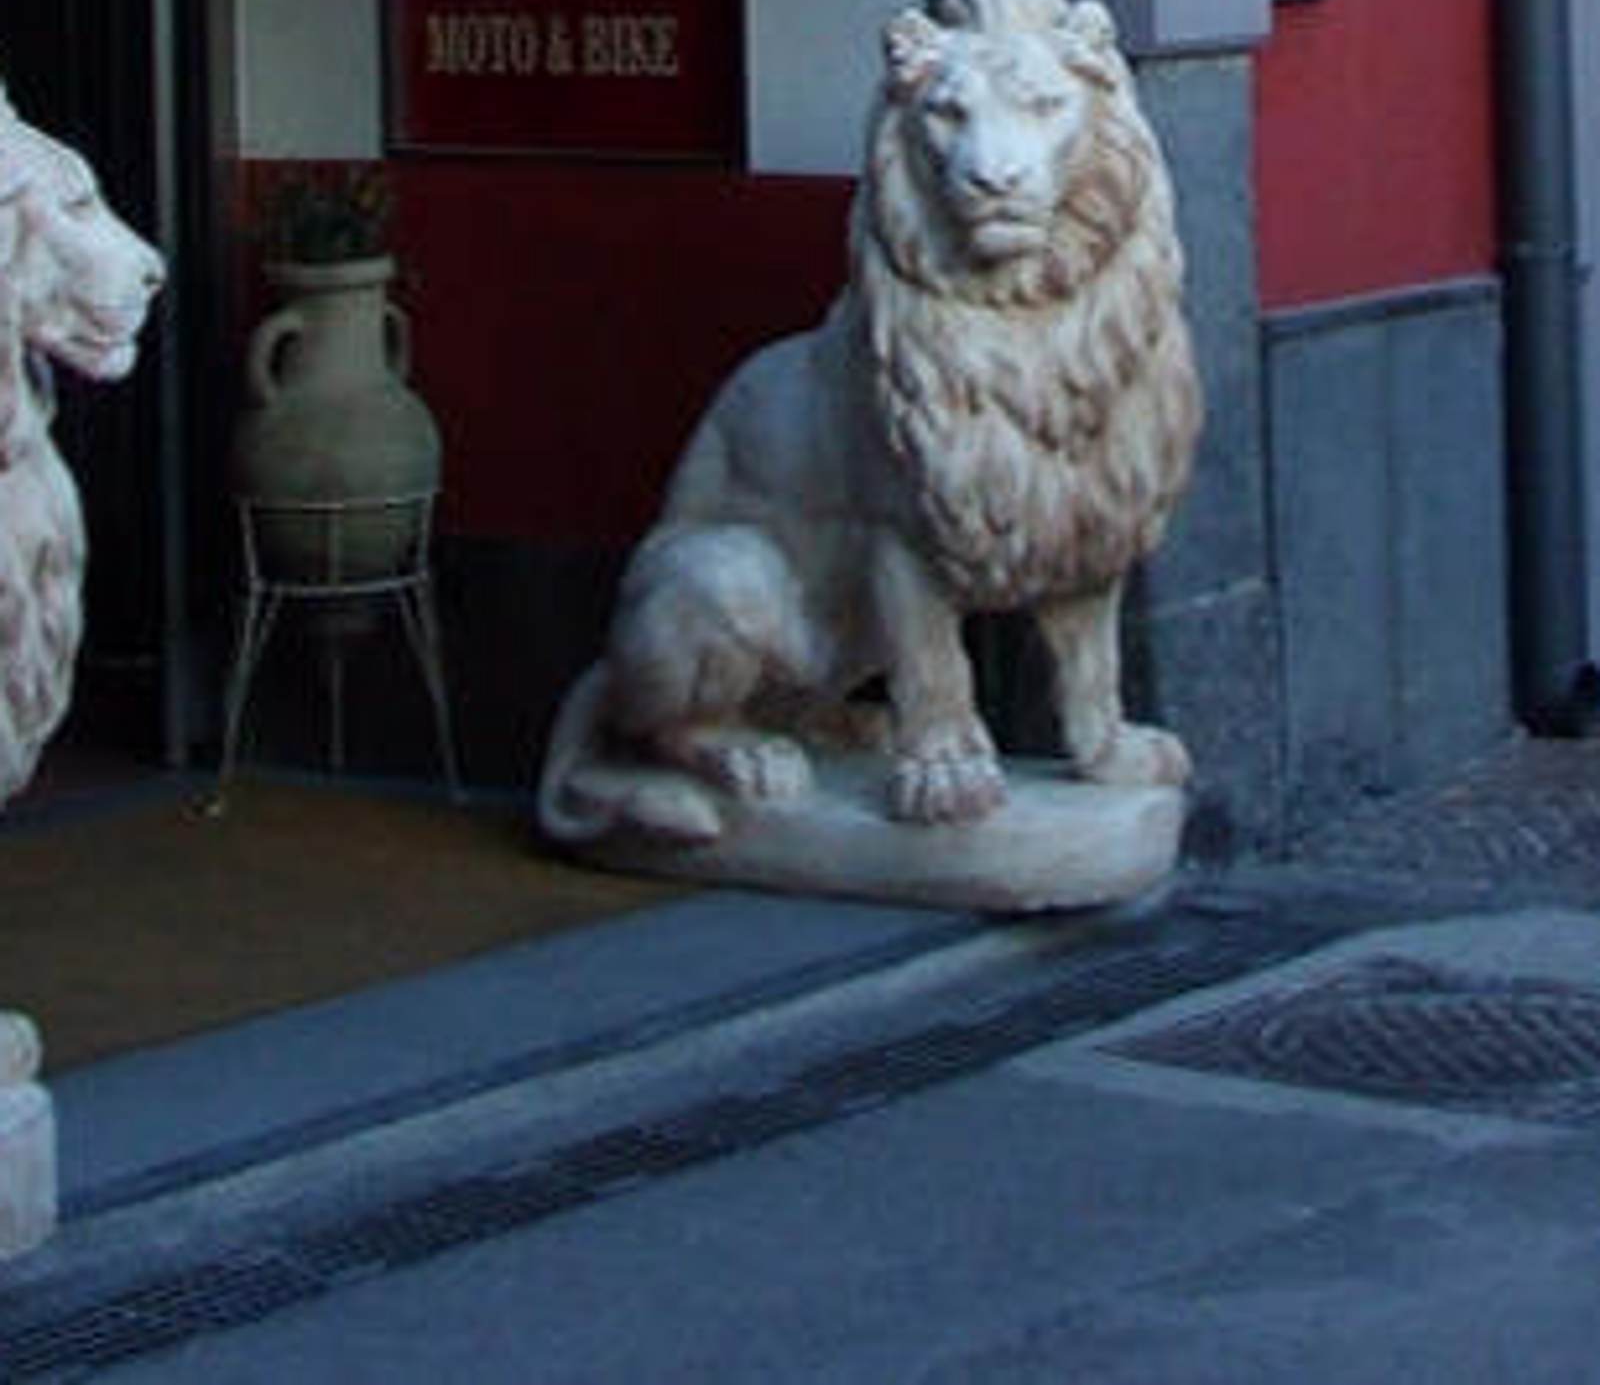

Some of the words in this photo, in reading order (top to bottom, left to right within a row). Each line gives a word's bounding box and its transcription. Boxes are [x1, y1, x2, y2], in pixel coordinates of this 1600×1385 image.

[425, 12, 540, 76] MOTO
[545, 13, 576, 76] &
[581, 12, 681, 77] BIKE
